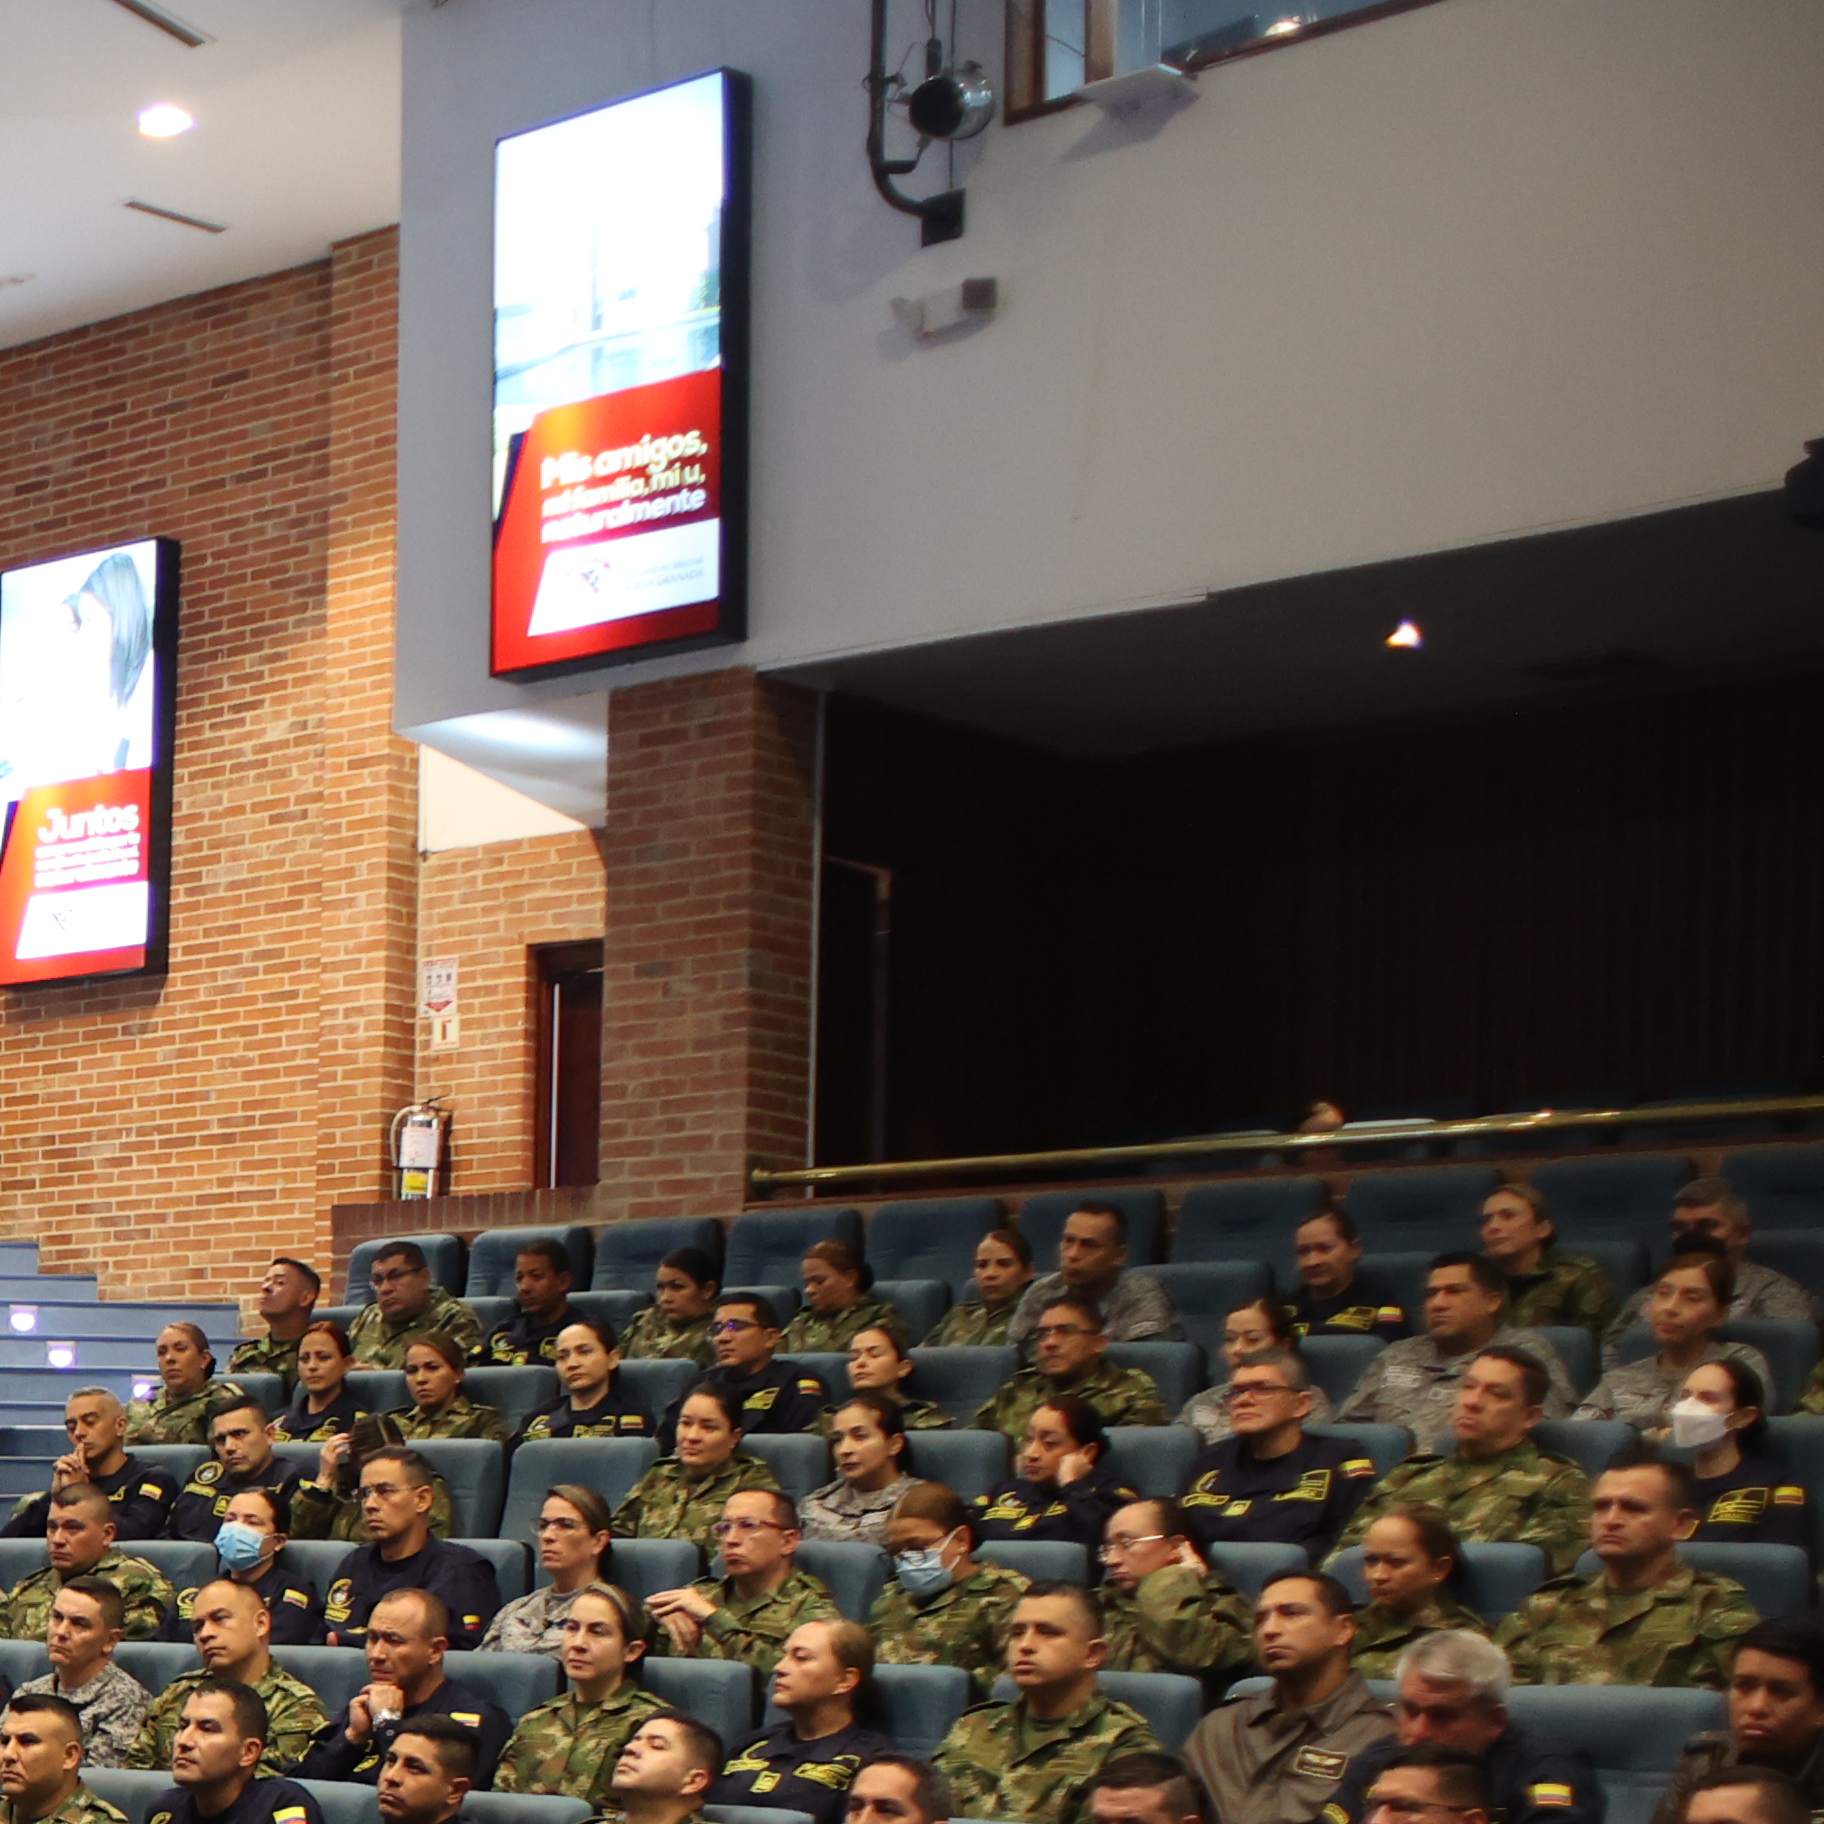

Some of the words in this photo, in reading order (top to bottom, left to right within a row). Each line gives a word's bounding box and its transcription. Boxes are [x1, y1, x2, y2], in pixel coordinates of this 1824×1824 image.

[540, 452, 592, 489] Mis
[594, 430, 708, 473] amigos,
[570, 476, 649, 511] familia,
[651, 462, 680, 491] mi
[682, 463, 706, 486] u,
[540, 488, 706, 543] naturalmente
[656, 568, 704, 586] GRANADA
[37, 804, 140, 843] Juntos
